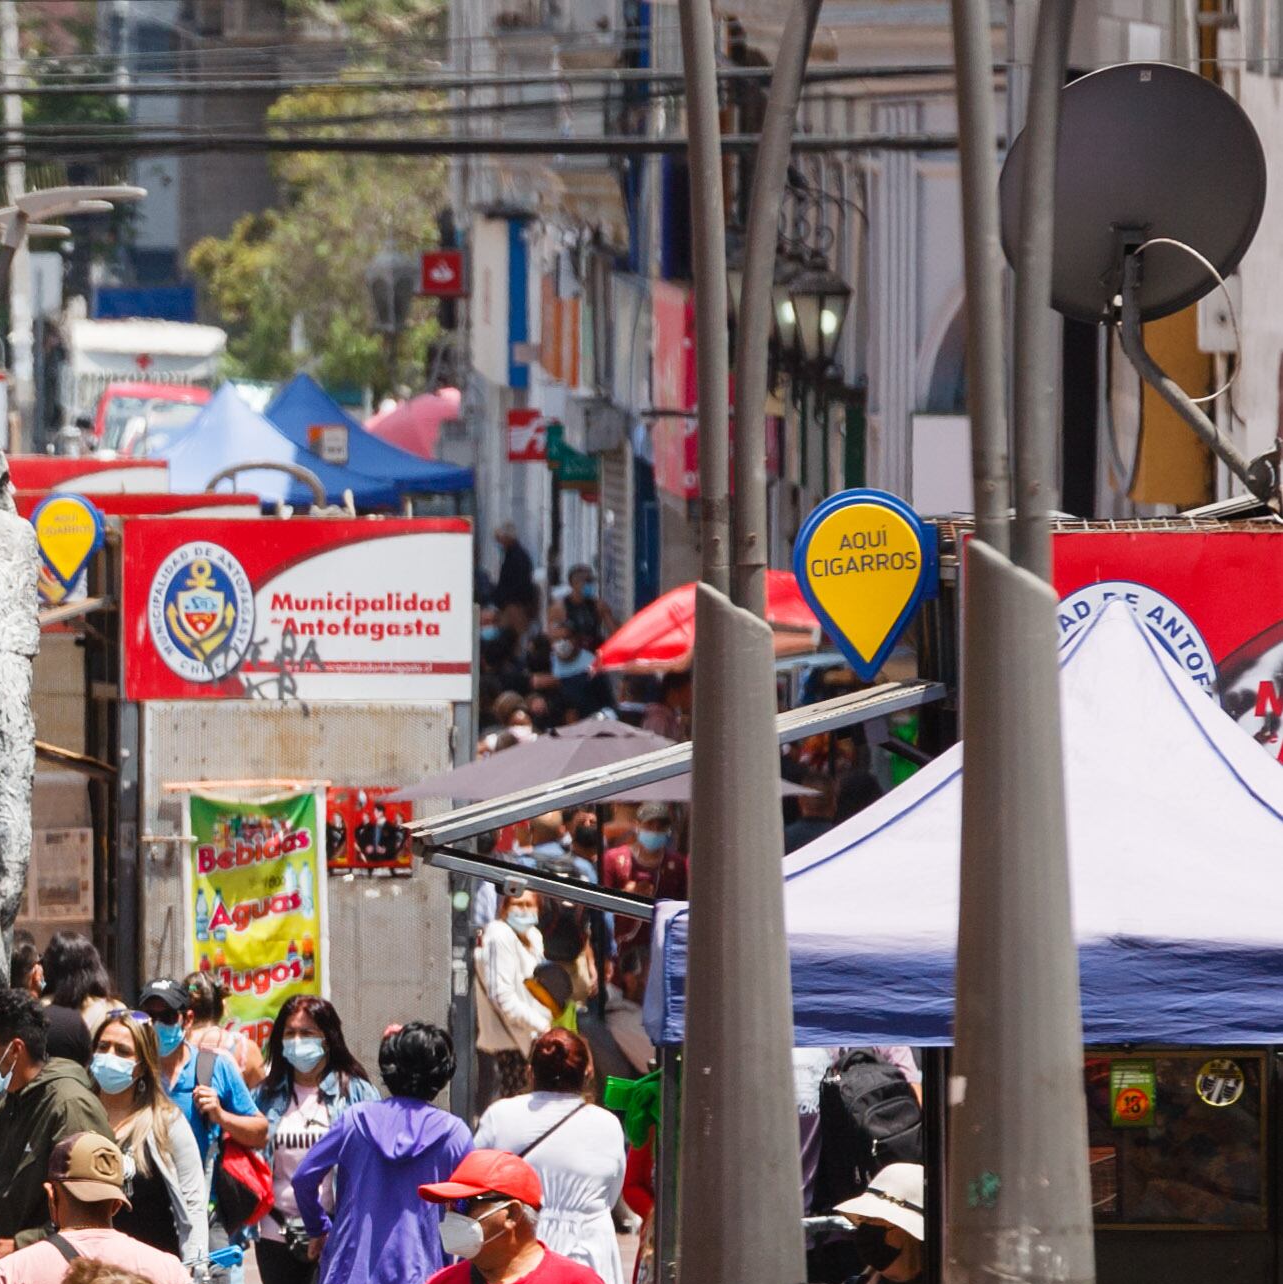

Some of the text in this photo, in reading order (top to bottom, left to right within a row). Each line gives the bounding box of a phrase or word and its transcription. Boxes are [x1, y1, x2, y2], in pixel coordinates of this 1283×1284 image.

[839, 524, 887, 550] AQUÍ
[811, 551, 918, 577] CIGARROS
[152, 550, 189, 656] MUNICIPALIDAD
[194, 547, 213, 557] DE
[270, 592, 452, 615] Municipalidad
[282, 617, 441, 640] Antofagasta
[197, 829, 312, 875] Bebidas
[207, 890, 303, 932] Aguas
